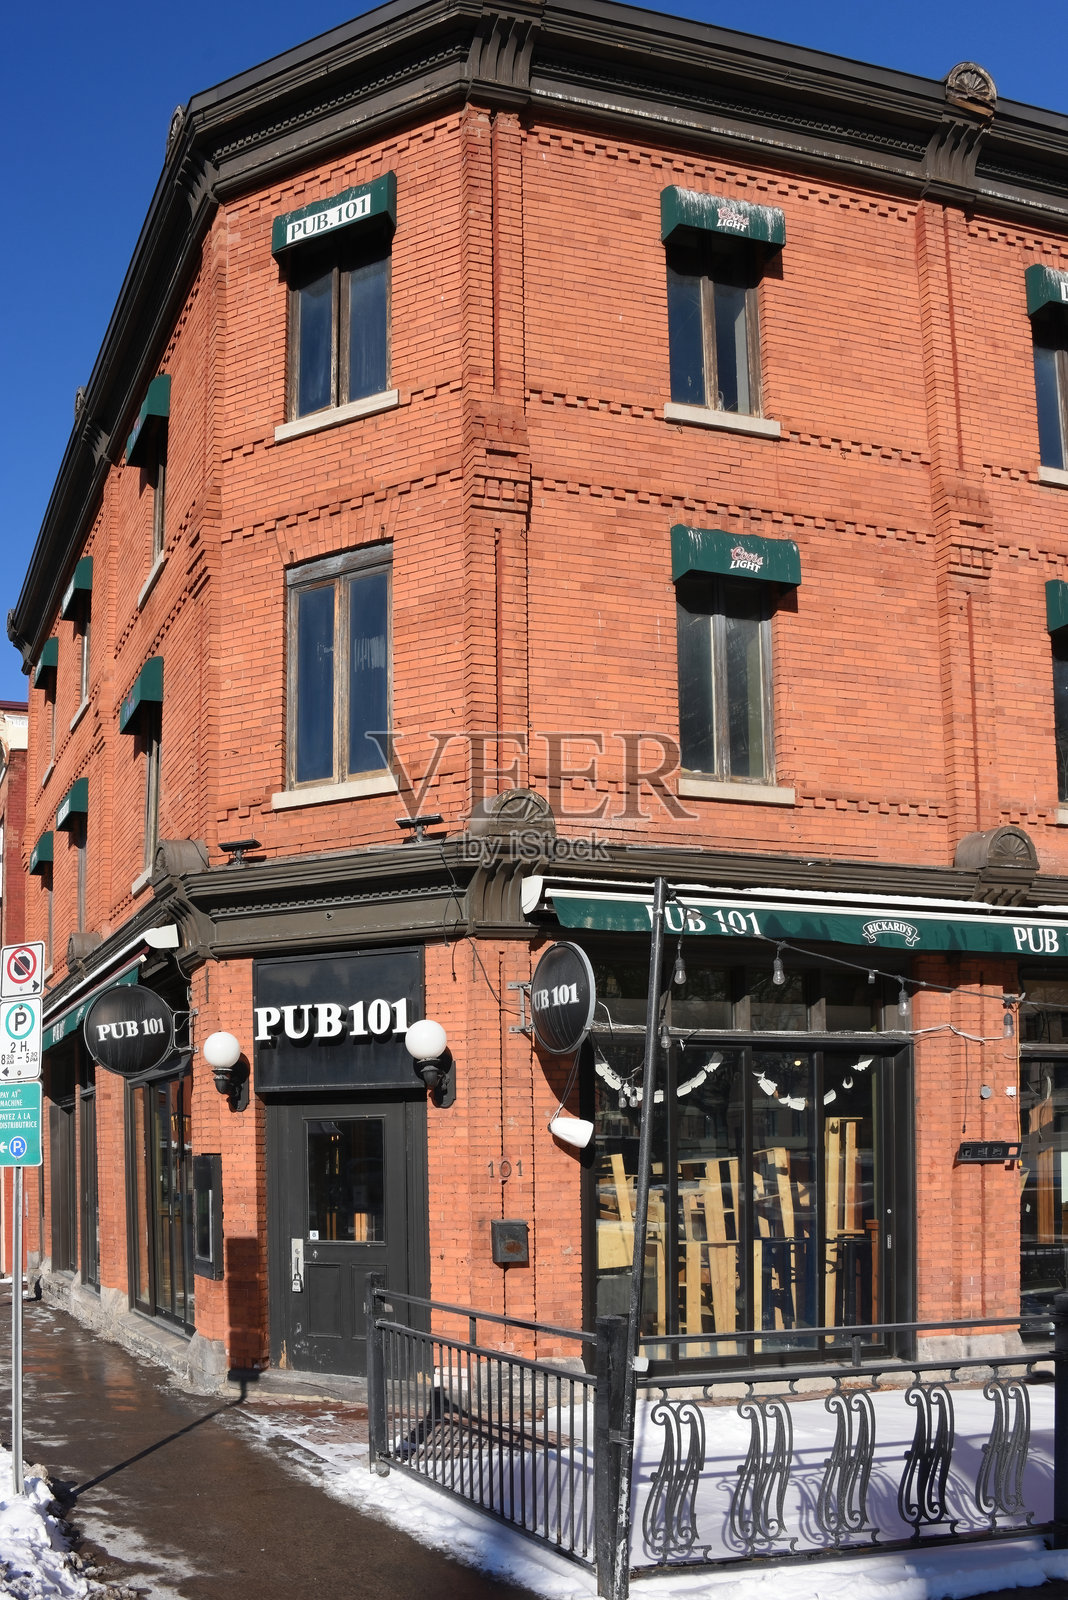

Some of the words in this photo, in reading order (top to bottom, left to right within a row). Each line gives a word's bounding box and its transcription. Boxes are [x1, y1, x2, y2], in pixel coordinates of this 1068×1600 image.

[336, 197, 366, 222] 101
[716, 219, 747, 232] LIGHT
[729, 560, 761, 573] LIGHT
[712, 909, 762, 935] 101
[866, 921, 913, 936] RICKARD'S
[1012, 926, 1060, 953] PUB
[550, 982, 580, 1007] 101
[254, 1002, 344, 1041] PUB
[348, 998, 410, 1036] 101
[96, 1020, 139, 1042] PUB
[141, 1017, 166, 1036] 101
[10, 1041, 17, 1054] 2
[11, 1090, 18, 1098] AT
[0, 1099, 23, 1107] MACHINE
[0, 1113, 16, 1121] PAYEZ
[23, 1112, 31, 1120] LA
[0, 1120, 38, 1129] DISTRIBUTRICE
[488, 1160, 523, 1178] 101
